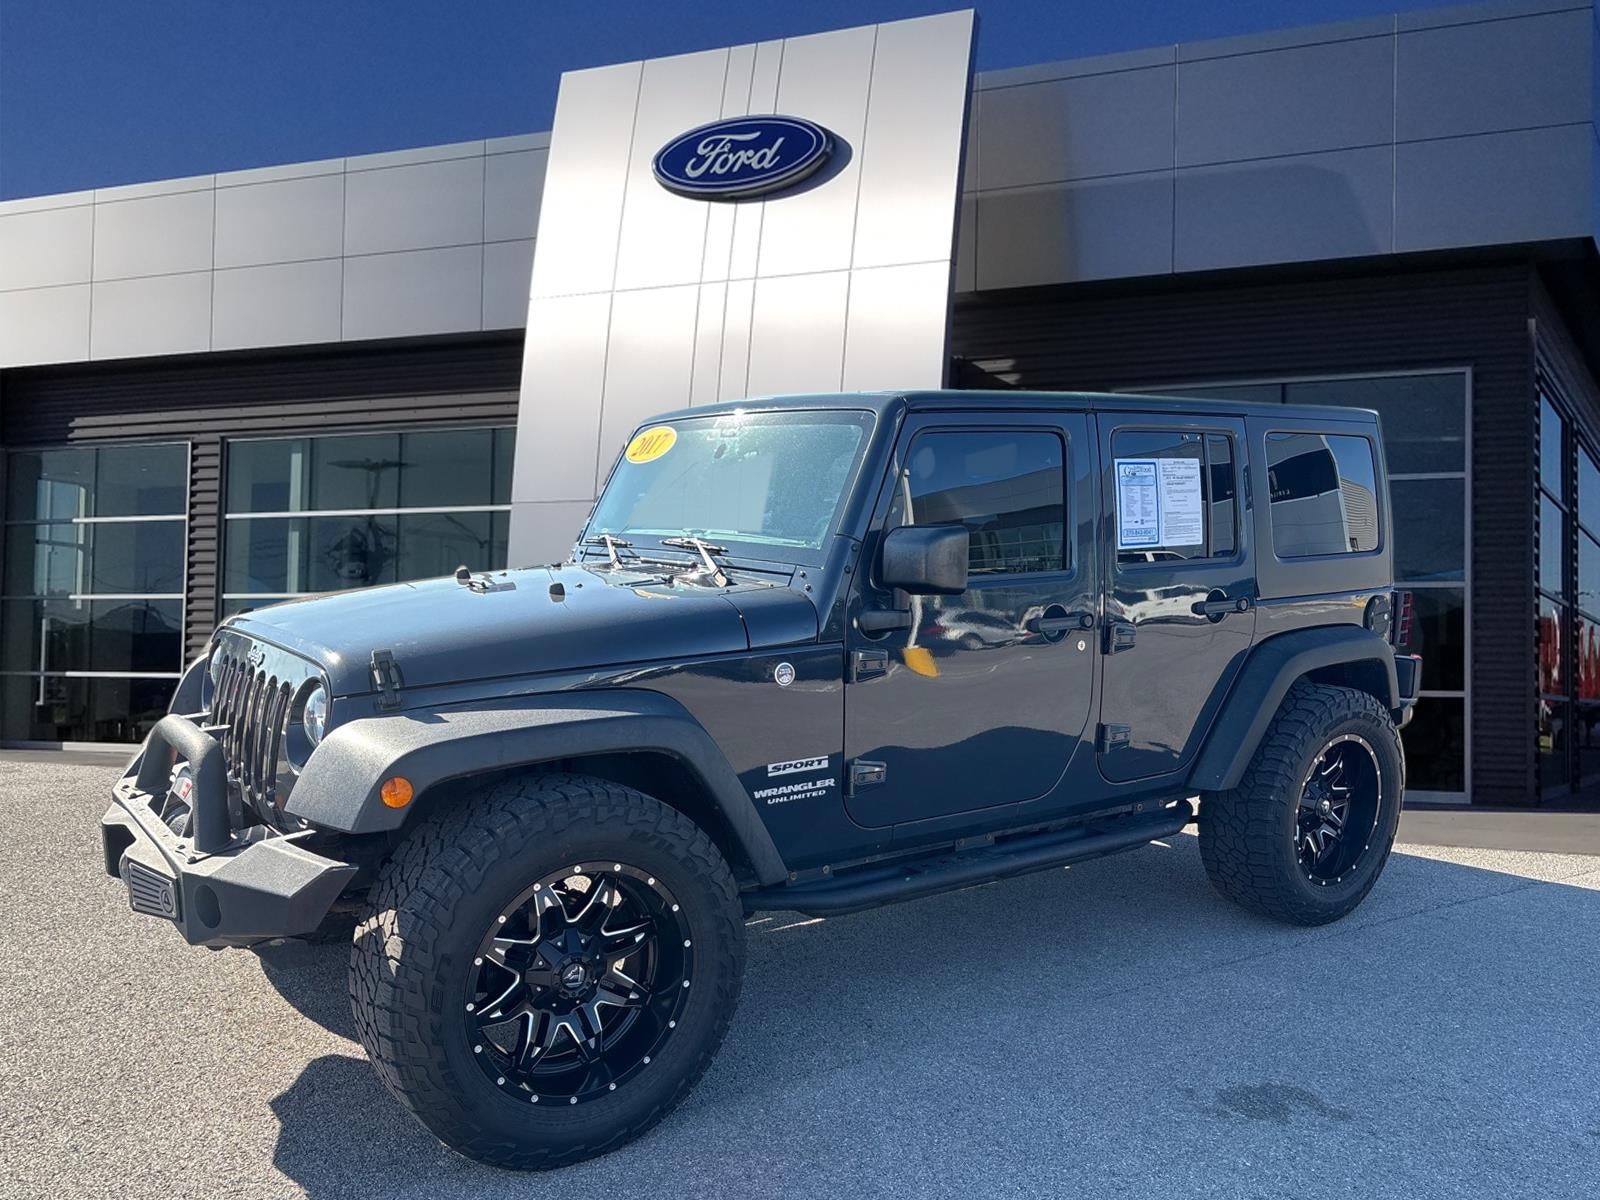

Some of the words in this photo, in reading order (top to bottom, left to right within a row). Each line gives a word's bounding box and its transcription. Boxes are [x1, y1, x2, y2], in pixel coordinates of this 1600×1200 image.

[685, 131, 785, 178] Ford
[629, 431, 673, 457] 2017
[769, 757, 825, 775] SPORT
[753, 778, 835, 799] WRANGLER
[767, 789, 826, 805] UNLIMITED
